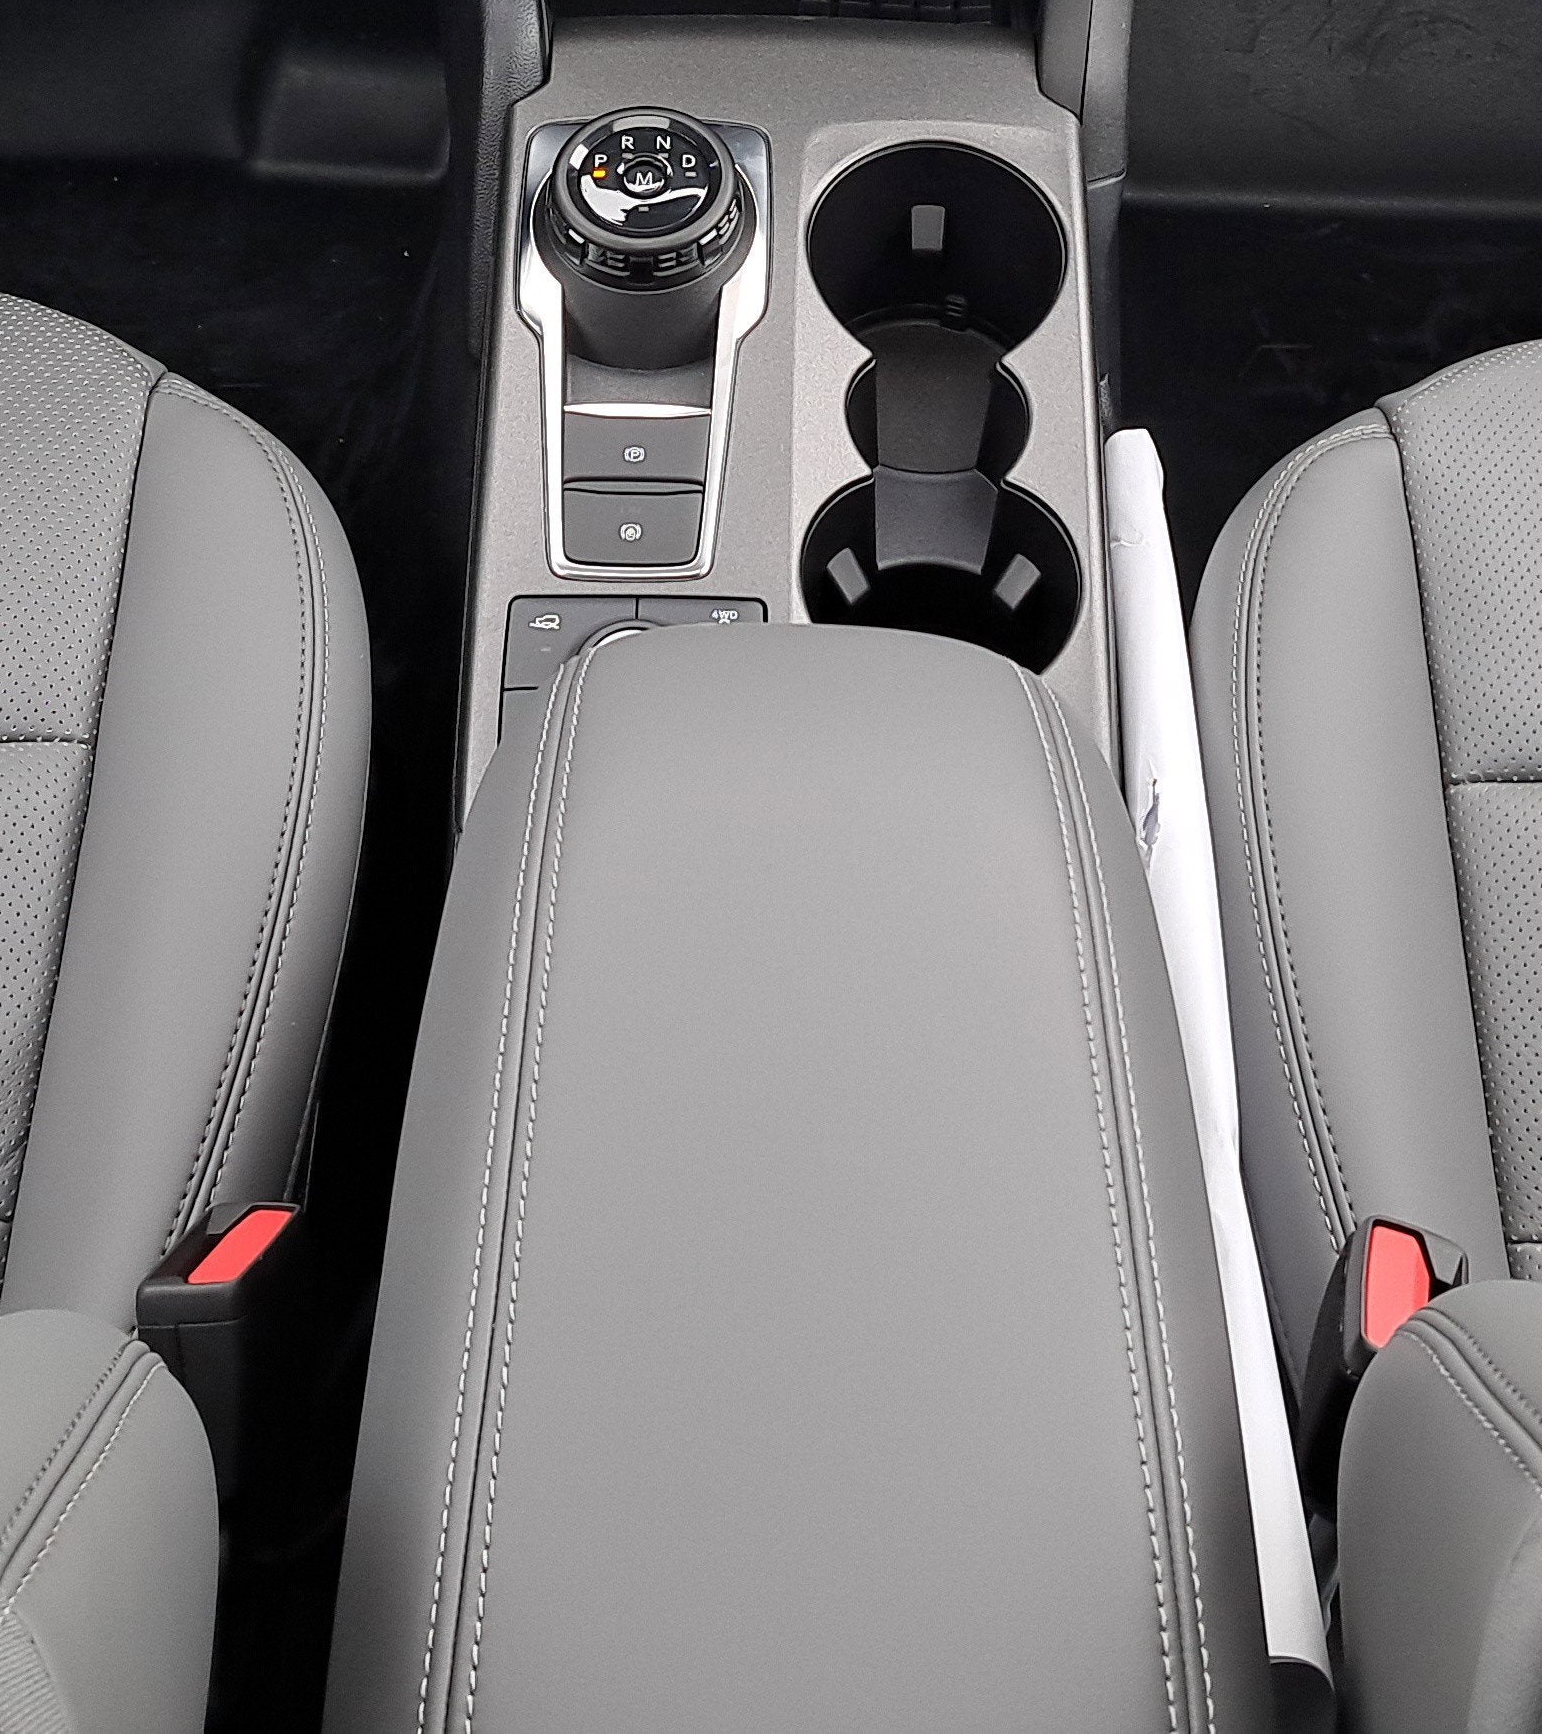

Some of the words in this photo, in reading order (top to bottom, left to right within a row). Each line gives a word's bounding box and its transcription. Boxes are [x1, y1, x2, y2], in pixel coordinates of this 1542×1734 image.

[621, 135, 635, 150] R
[656, 135, 671, 150] N
[594, 154, 608, 167] P
[682, 154, 696, 168] D
[635, 171, 653, 185] M
[711, 610, 738, 620] 4WD
